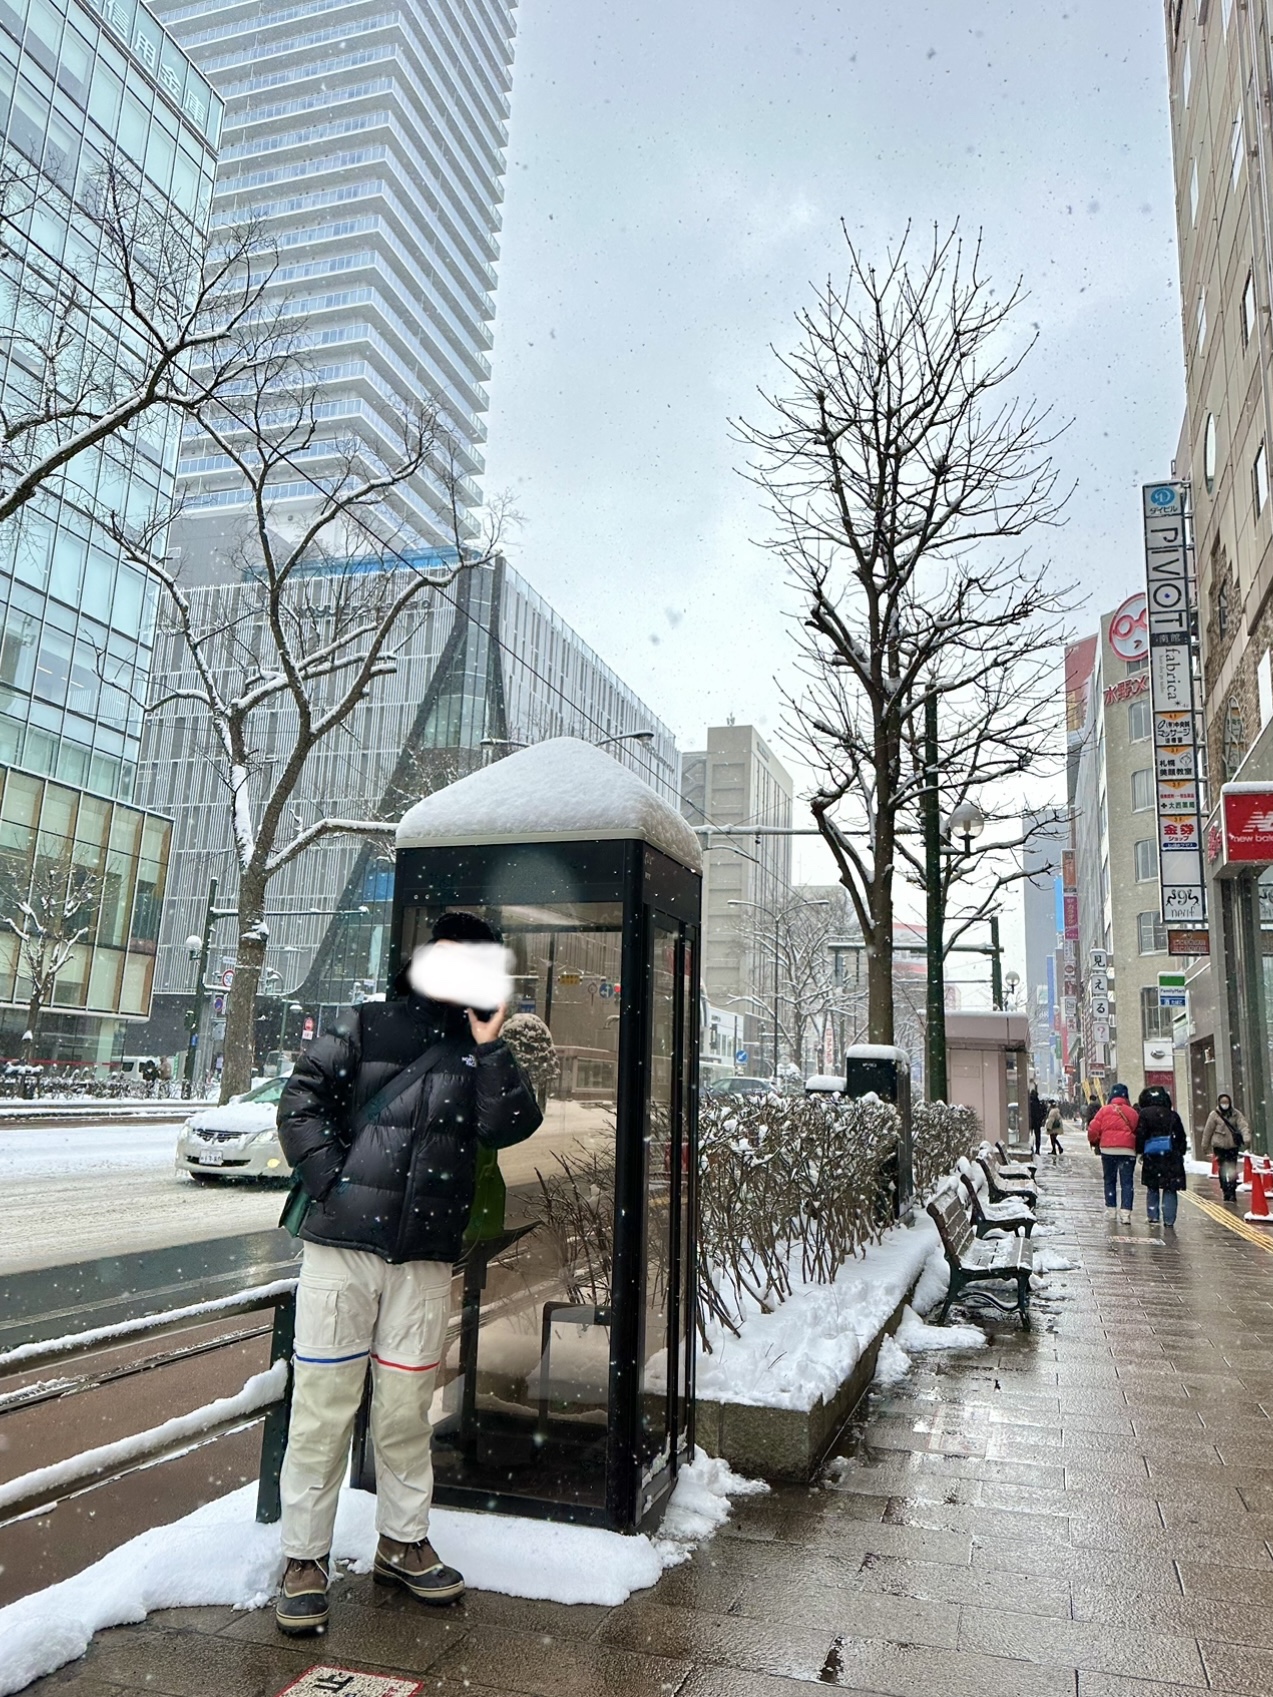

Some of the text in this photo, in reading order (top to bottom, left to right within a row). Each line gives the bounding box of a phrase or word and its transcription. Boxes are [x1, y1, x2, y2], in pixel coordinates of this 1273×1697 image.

[88, 0, 206, 126] 信用金庫
[1149, 506, 1178, 515] ダイビル
[1151, 527, 1183, 628] PIVOT
[1165, 648, 1181, 700] fabrica
[1102, 672, 1148, 705] 水野メ
[1157, 728, 1190, 737] マッサージ
[1159, 759, 1175, 767] 札幌
[1164, 824, 1194, 835] 金券
[1233, 835, 1253, 843] new
[1171, 906, 1195, 918] neuf
